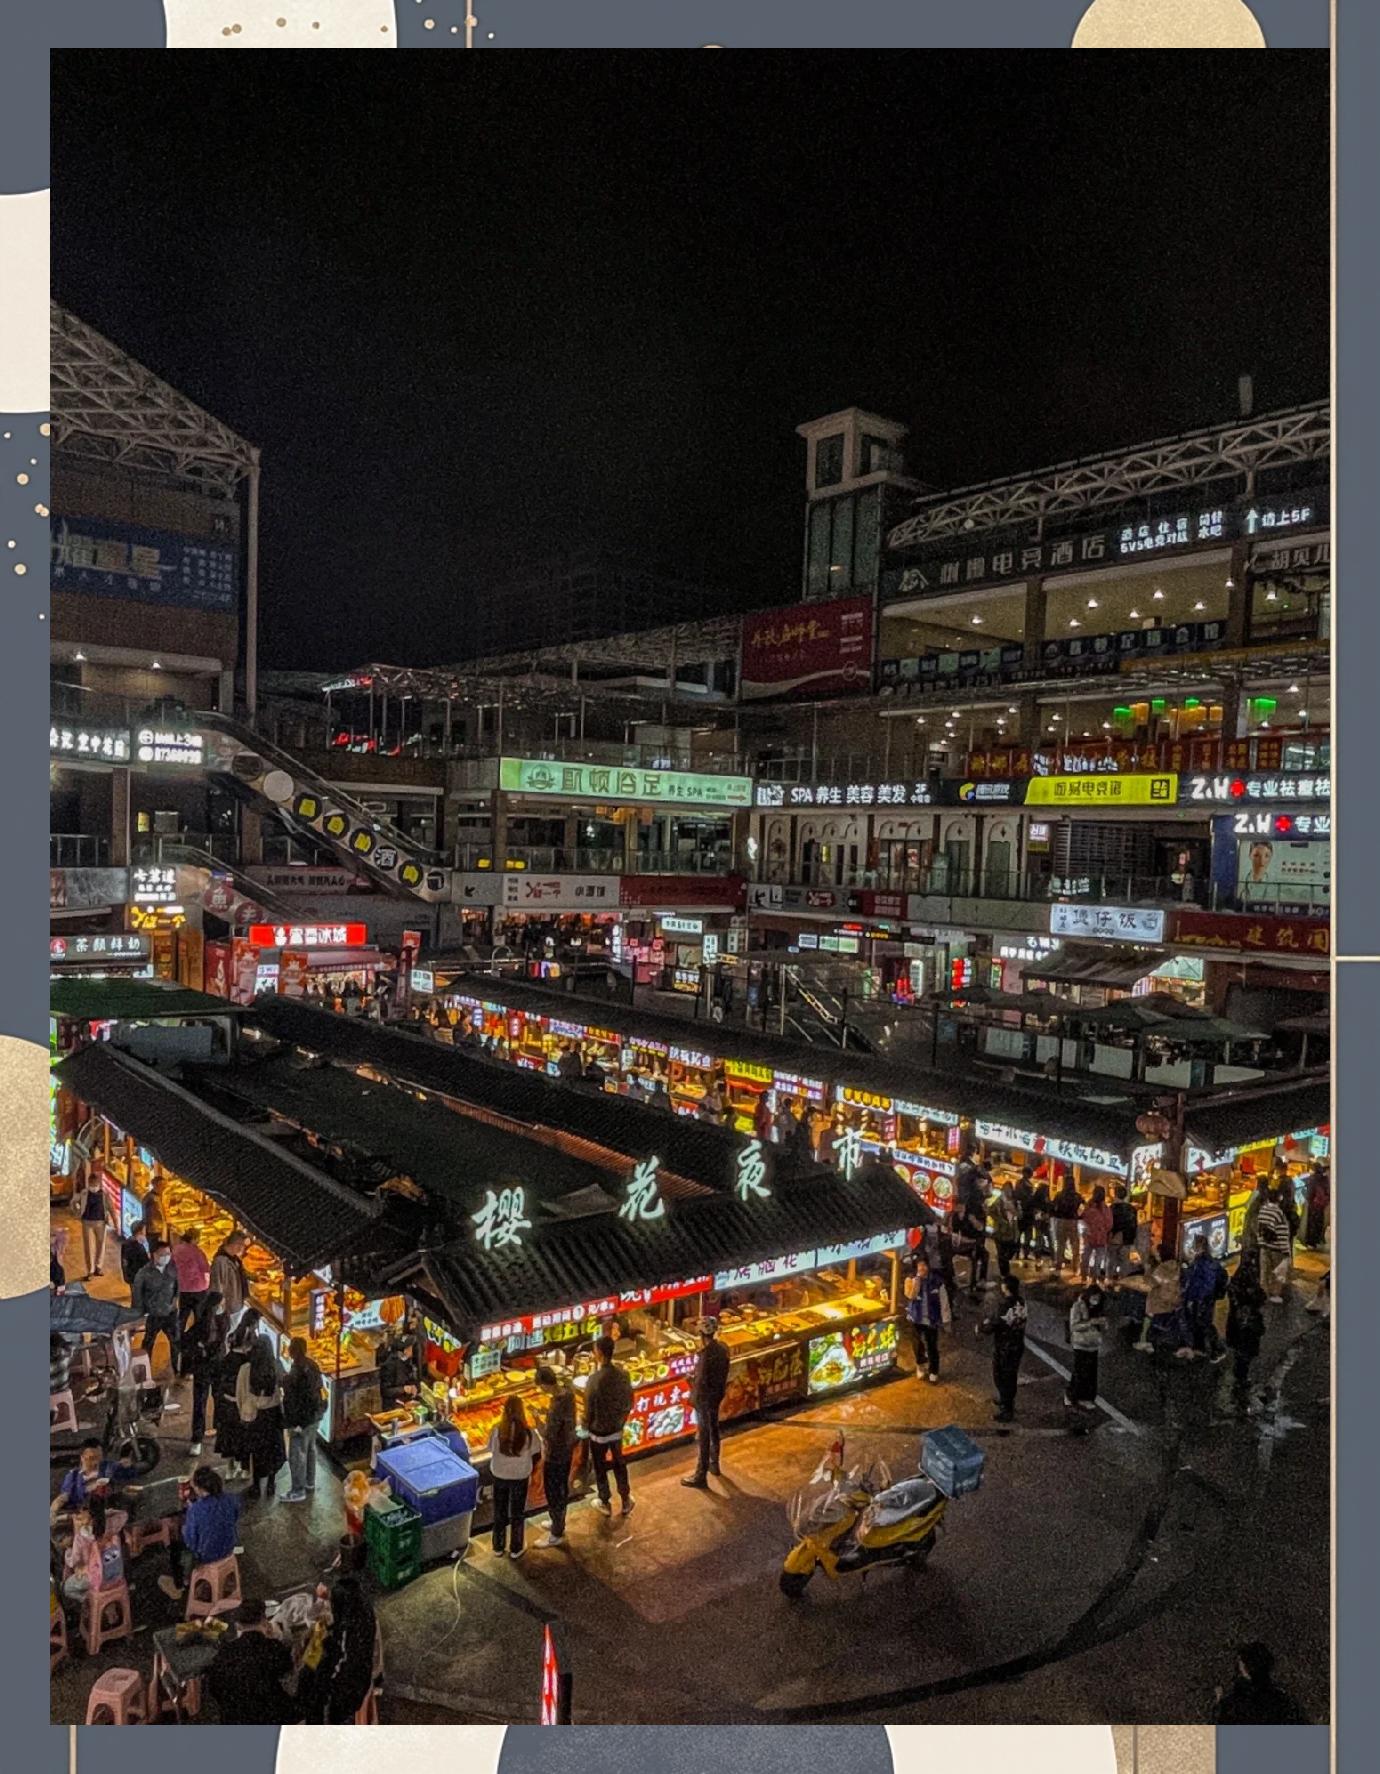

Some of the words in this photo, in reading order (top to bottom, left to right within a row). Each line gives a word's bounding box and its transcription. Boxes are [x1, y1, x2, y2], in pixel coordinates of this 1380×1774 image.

[791, 787, 814, 803] SPA
[816, 785, 842, 804] 养生
[847, 784, 875, 804] 美容
[877, 783, 906, 804] 美发
[1073, 909, 1137, 929] 煲仔饭
[471, 1128, 866, 1250] 樱花夜市
